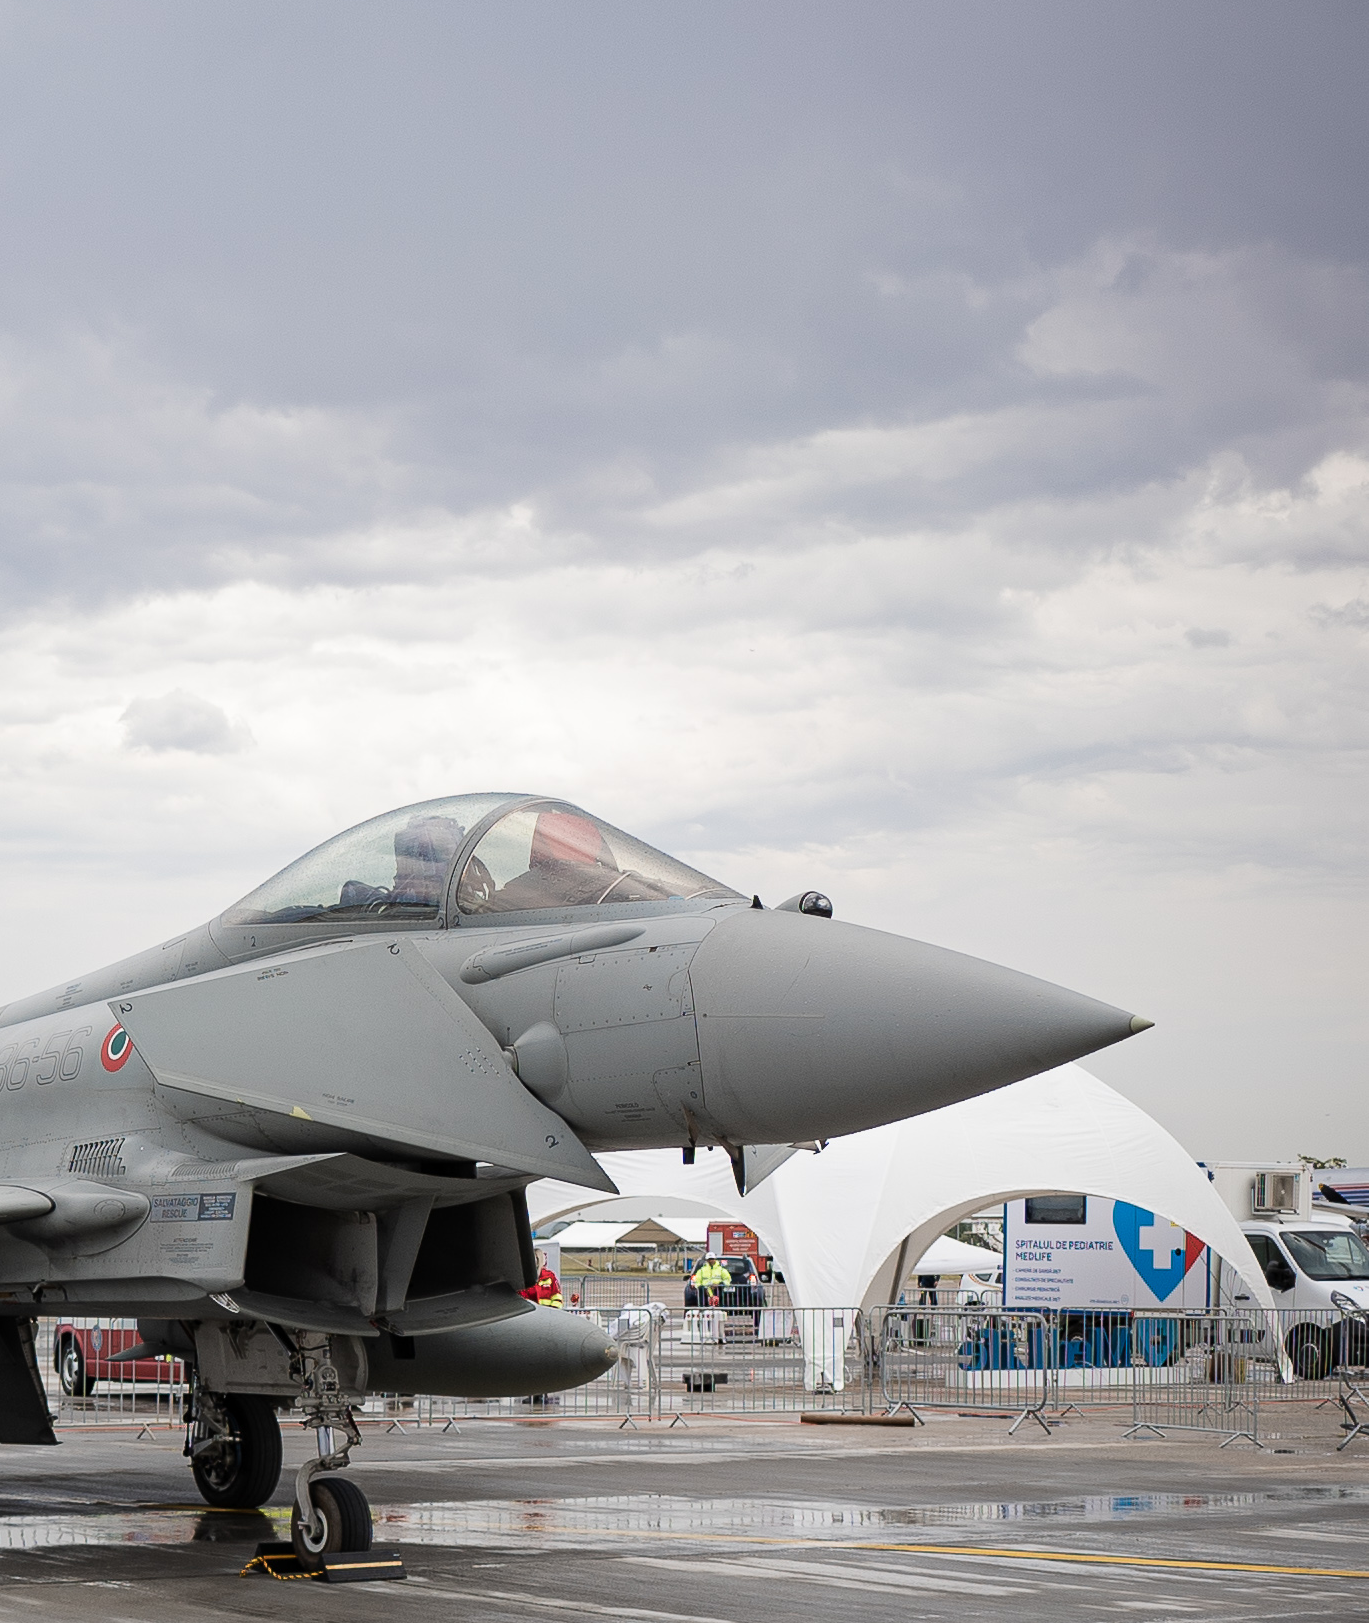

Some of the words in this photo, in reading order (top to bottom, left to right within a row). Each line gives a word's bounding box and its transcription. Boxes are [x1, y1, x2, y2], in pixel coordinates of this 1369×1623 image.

[453, 914, 461, 927] 2
[250, 935, 256, 947] 2
[545, 1134, 560, 1148] 2
[154, 1197, 199, 1208] SALVATAGGIO
[162, 1208, 188, 1219] RESCUE
[1015, 1239, 1055, 1250] SPITALUL
[1055, 1240, 1068, 1250] DE
[1069, 1240, 1114, 1250] PEDIATRIE
[1015, 1252, 1052, 1261] MEDLIFE
